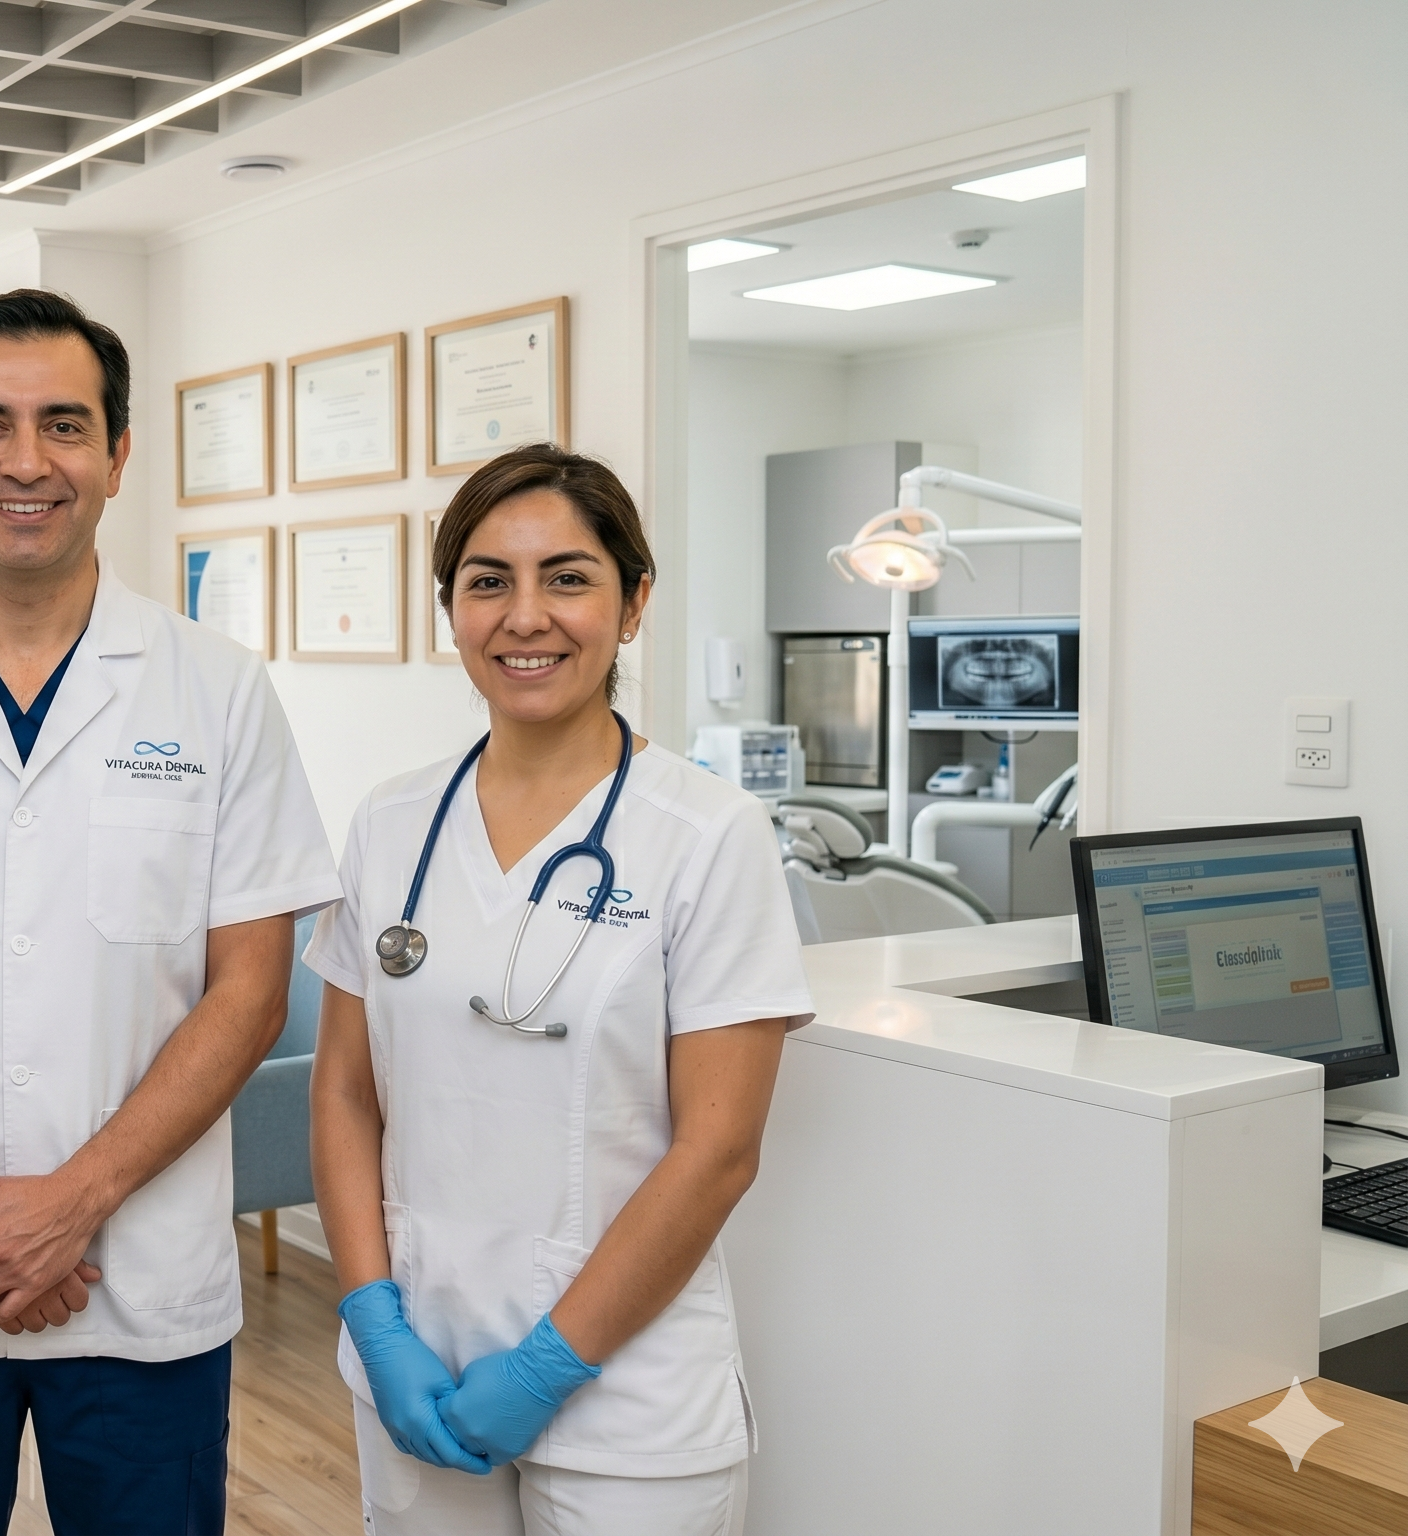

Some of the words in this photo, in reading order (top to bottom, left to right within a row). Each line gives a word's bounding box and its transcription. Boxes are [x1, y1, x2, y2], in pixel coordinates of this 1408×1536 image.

[105, 759, 163, 771] VITACURA
[165, 761, 207, 775] DENTAL
[609, 906, 651, 920] DENTAL
